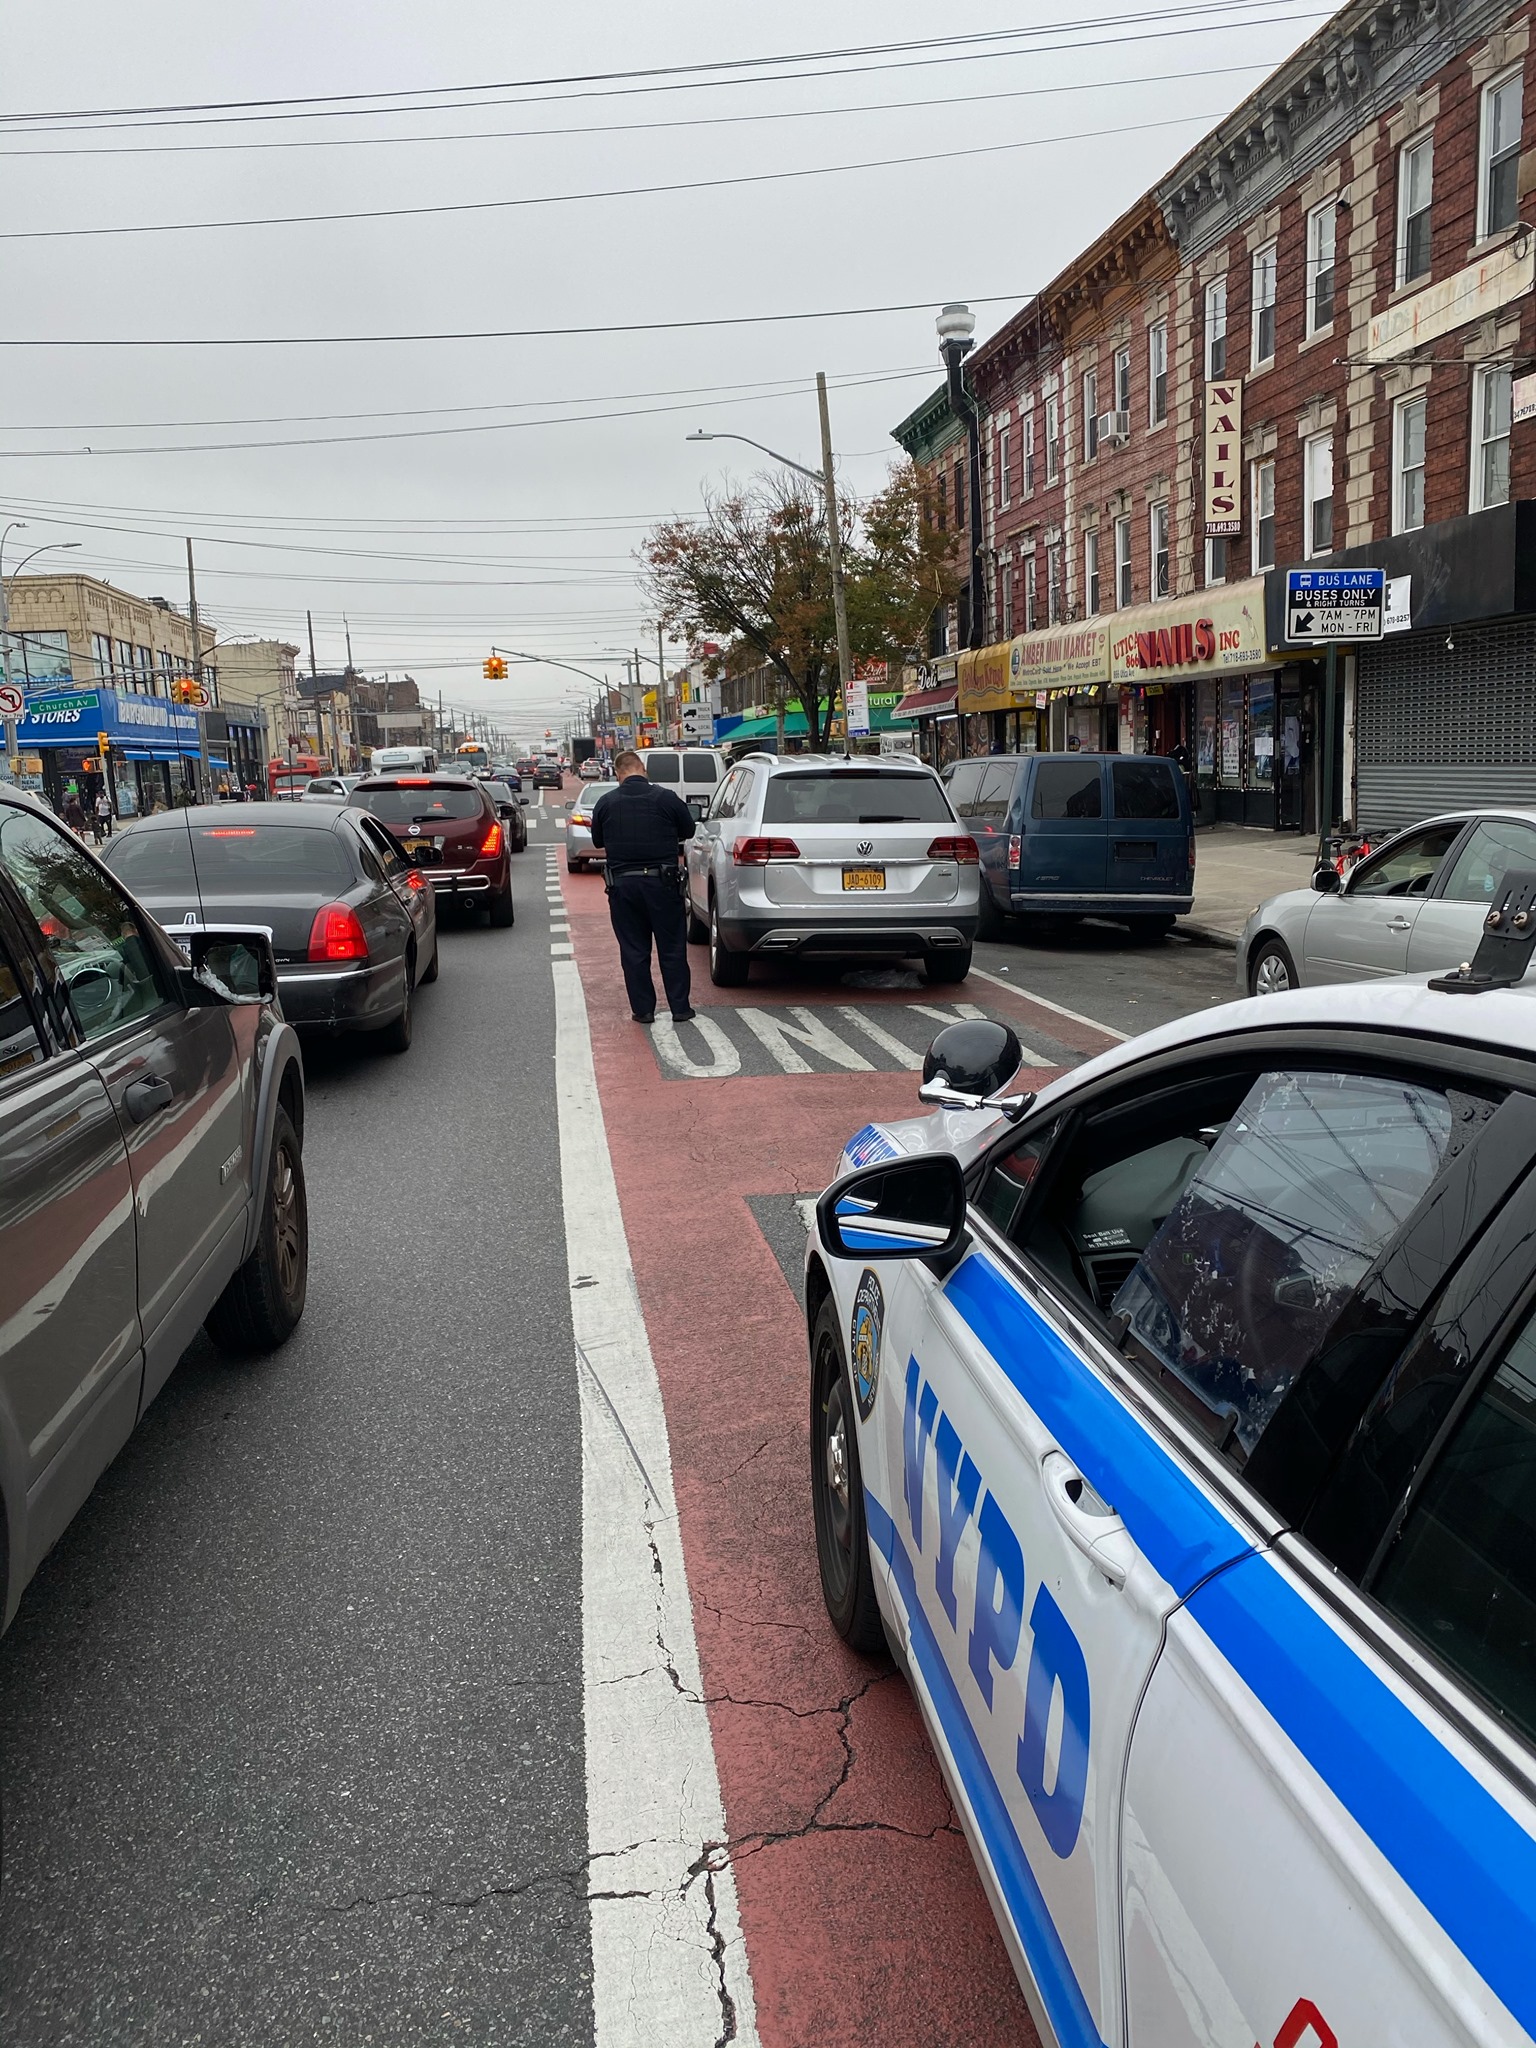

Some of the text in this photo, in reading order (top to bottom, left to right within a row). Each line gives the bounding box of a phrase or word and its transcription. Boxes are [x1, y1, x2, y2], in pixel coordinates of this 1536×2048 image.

[1209, 386, 1238, 515] NAILS
[1206, 522, 1241, 533] 718.693.3580
[1318, 574, 1373, 586] BUS LANE
[1295, 589, 1376, 601] BUSES ONLY
[1320, 610, 1342, 620] 7AM
[1354, 609, 1376, 619] 7PM
[1321, 622, 1344, 632] MON
[1356, 622, 1373, 632] FRI
[1021, 642, 1044, 666] AMBER
[1045, 638, 1061, 662] MINI
[1063, 632, 1097, 660] MARKET
[1137, 618, 1216, 669] NAILS
[1219, 630, 1240, 650] INC
[918, 665, 938, 690] Deli
[39, 699, 88, 712] Church Av
[31, 708, 81, 724] STORES
[1109, 1238, 1131, 1246] Vehicle
[866, 1275, 880, 1307] POLICE
[903, 1353, 1091, 1860] NYPD
